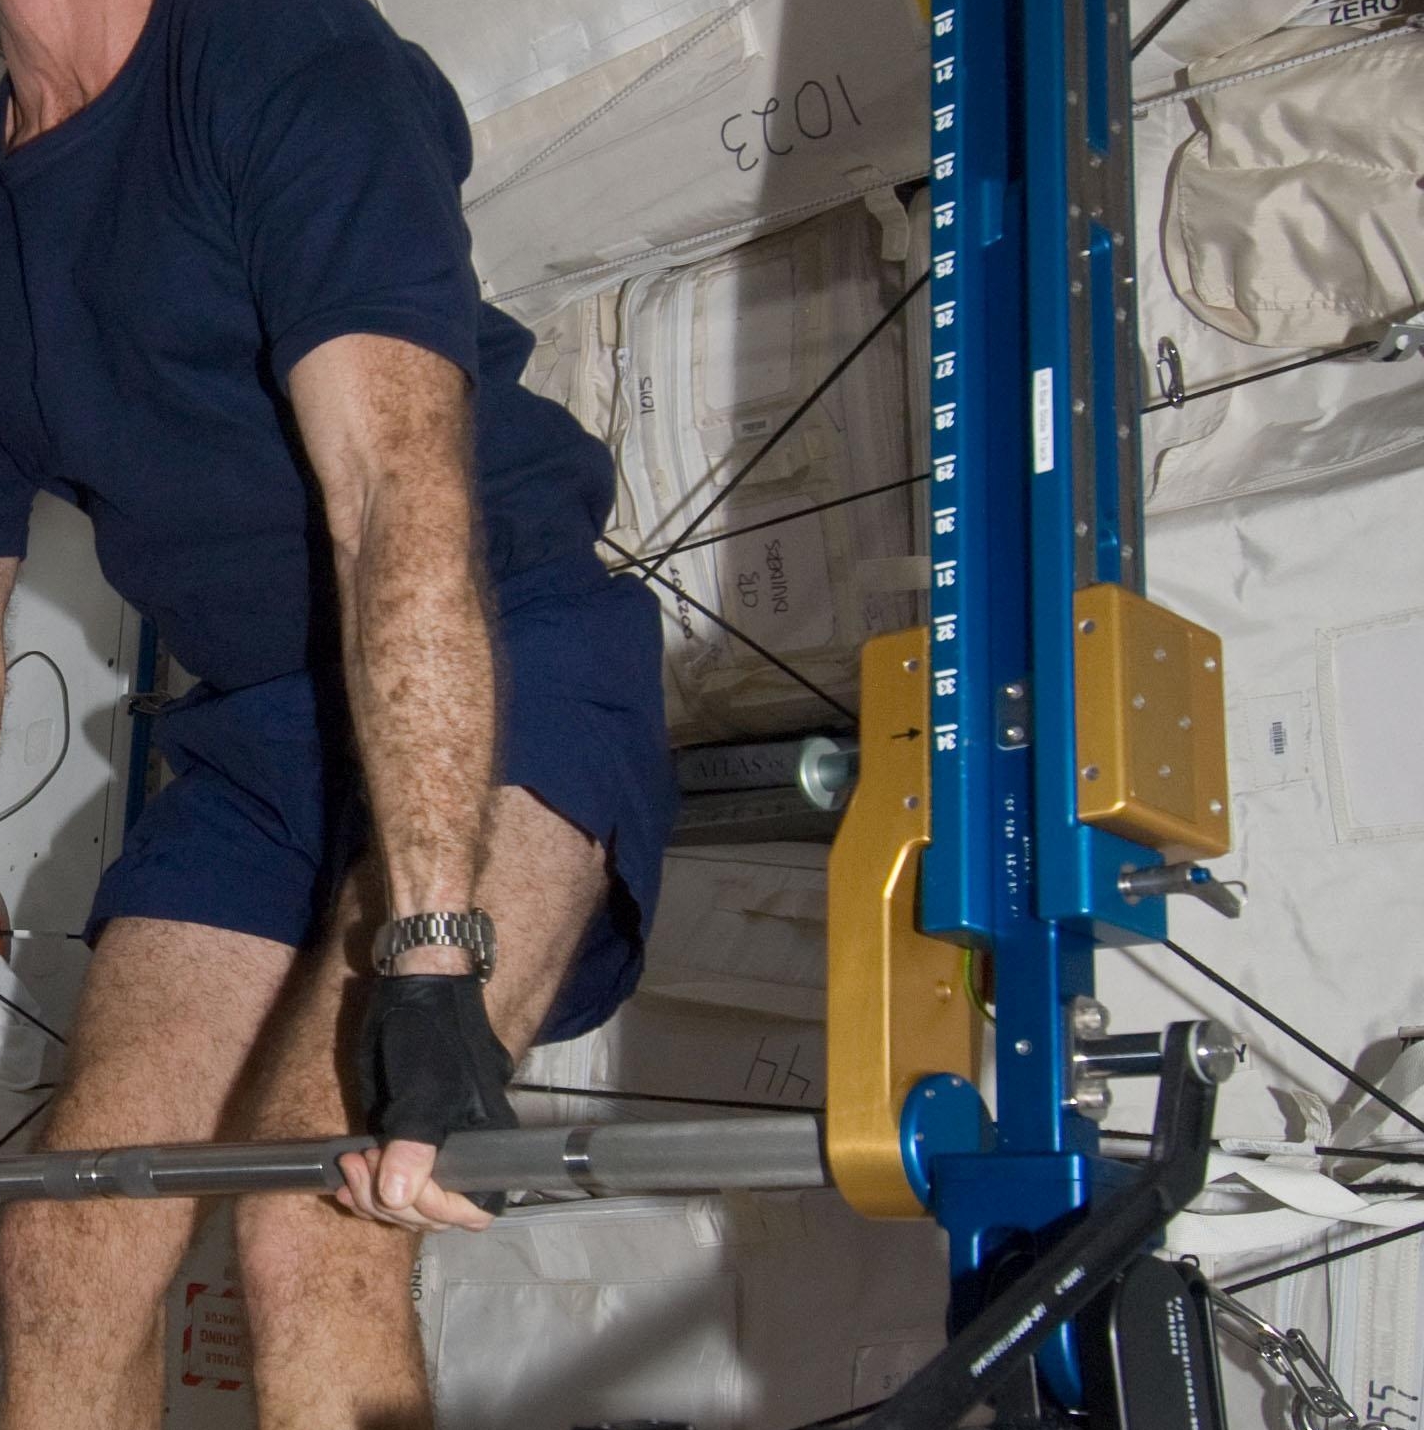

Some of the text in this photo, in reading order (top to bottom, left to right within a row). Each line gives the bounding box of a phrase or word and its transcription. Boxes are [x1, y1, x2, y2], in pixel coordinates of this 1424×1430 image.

[935, 18, 953, 37] 20
[936, 65, 953, 84] 21
[720, 74, 862, 172] 1023
[935, 112, 954, 132] 22
[935, 161, 954, 180] 23
[935, 210, 954, 229] 24
[934, 259, 954, 279] 25
[935, 310, 954, 329] 26
[935, 360, 955, 380] 27
[639, 375, 655, 416] 1015
[935, 412, 955, 431] 28
[935, 464, 955, 482] 29
[935, 516, 955, 535] 30
[764, 538, 789, 614] DIVIDERS
[936, 569, 955, 588] 31
[936, 623, 956, 642] 32
[935, 678, 956, 696] 33
[936, 733, 957, 752] 34
